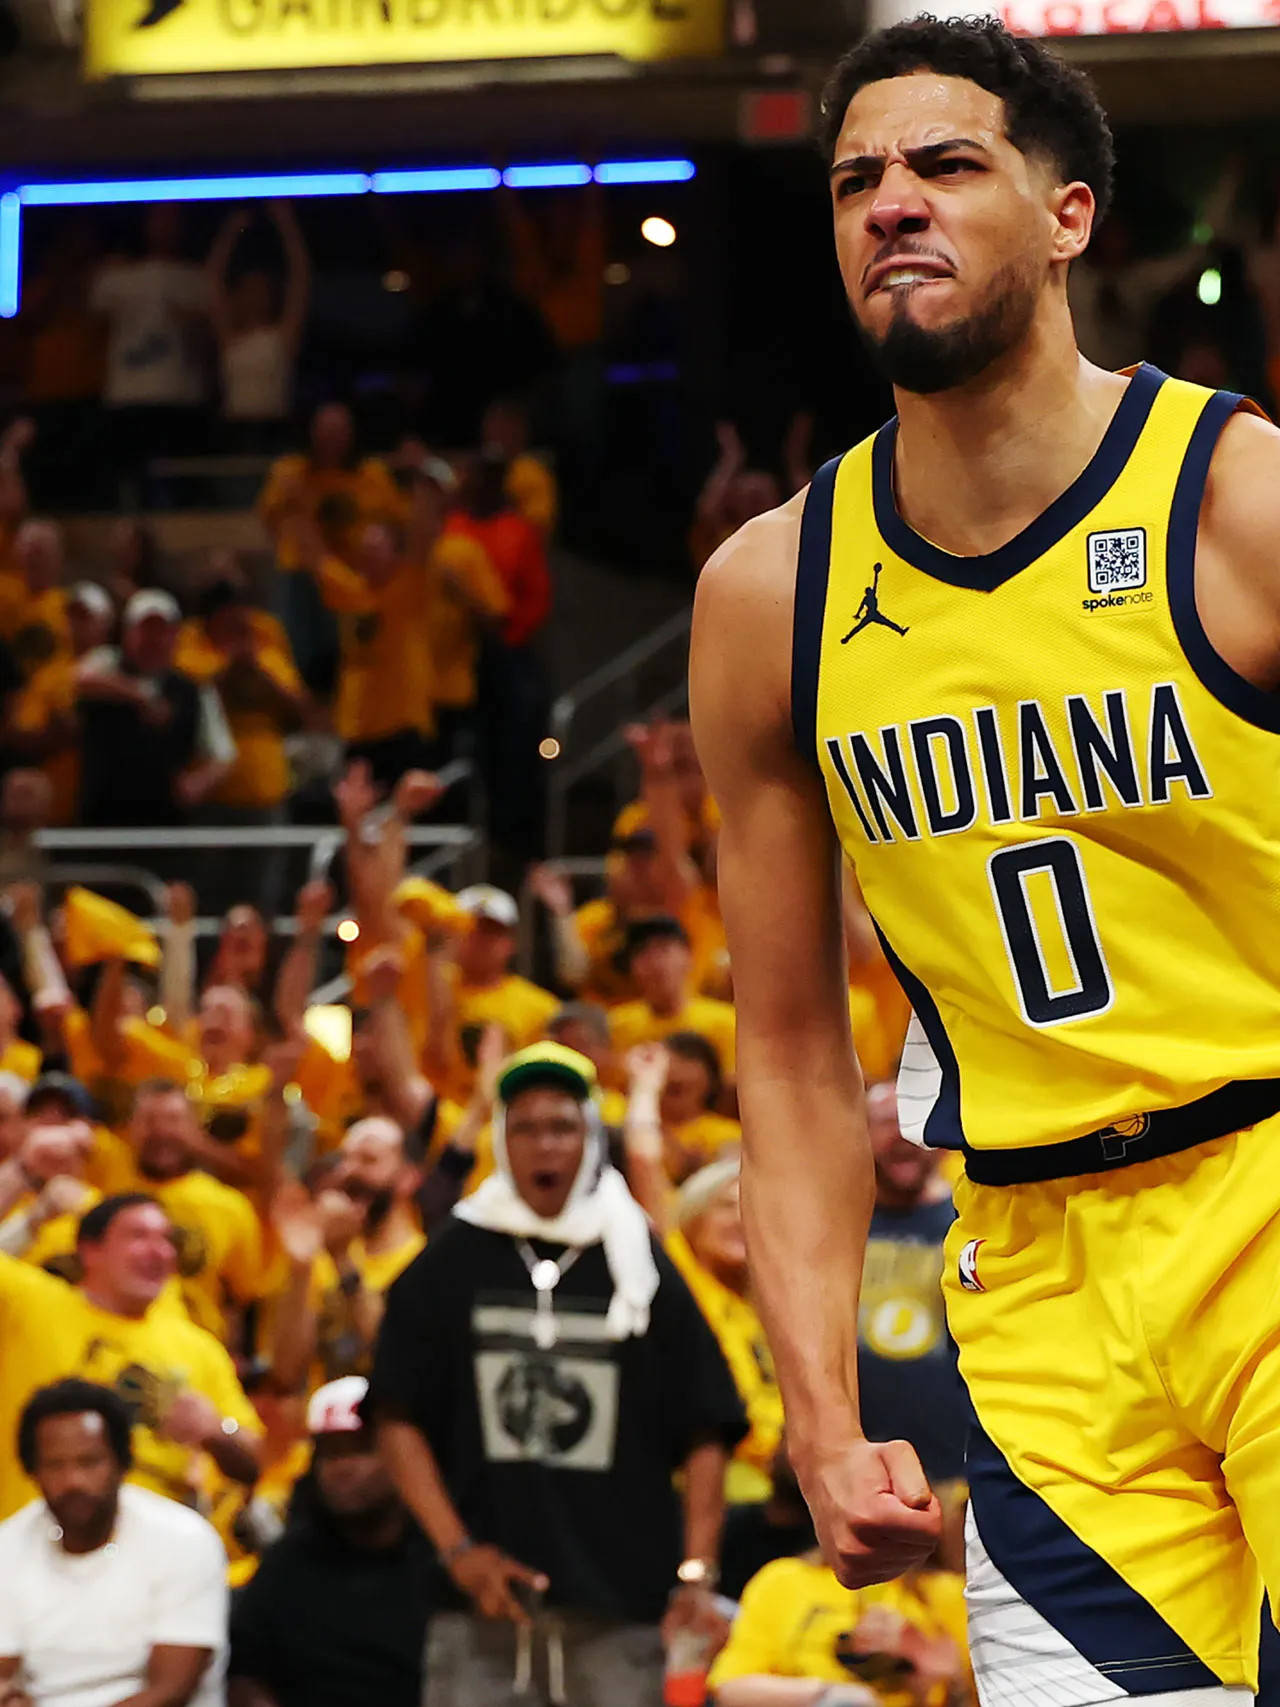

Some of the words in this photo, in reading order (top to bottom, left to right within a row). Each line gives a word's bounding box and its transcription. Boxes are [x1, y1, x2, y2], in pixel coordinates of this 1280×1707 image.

[1082, 591, 1153, 612] spokenote
[824, 681, 1213, 844] INDIANA
[986, 836, 1115, 1029] 0
